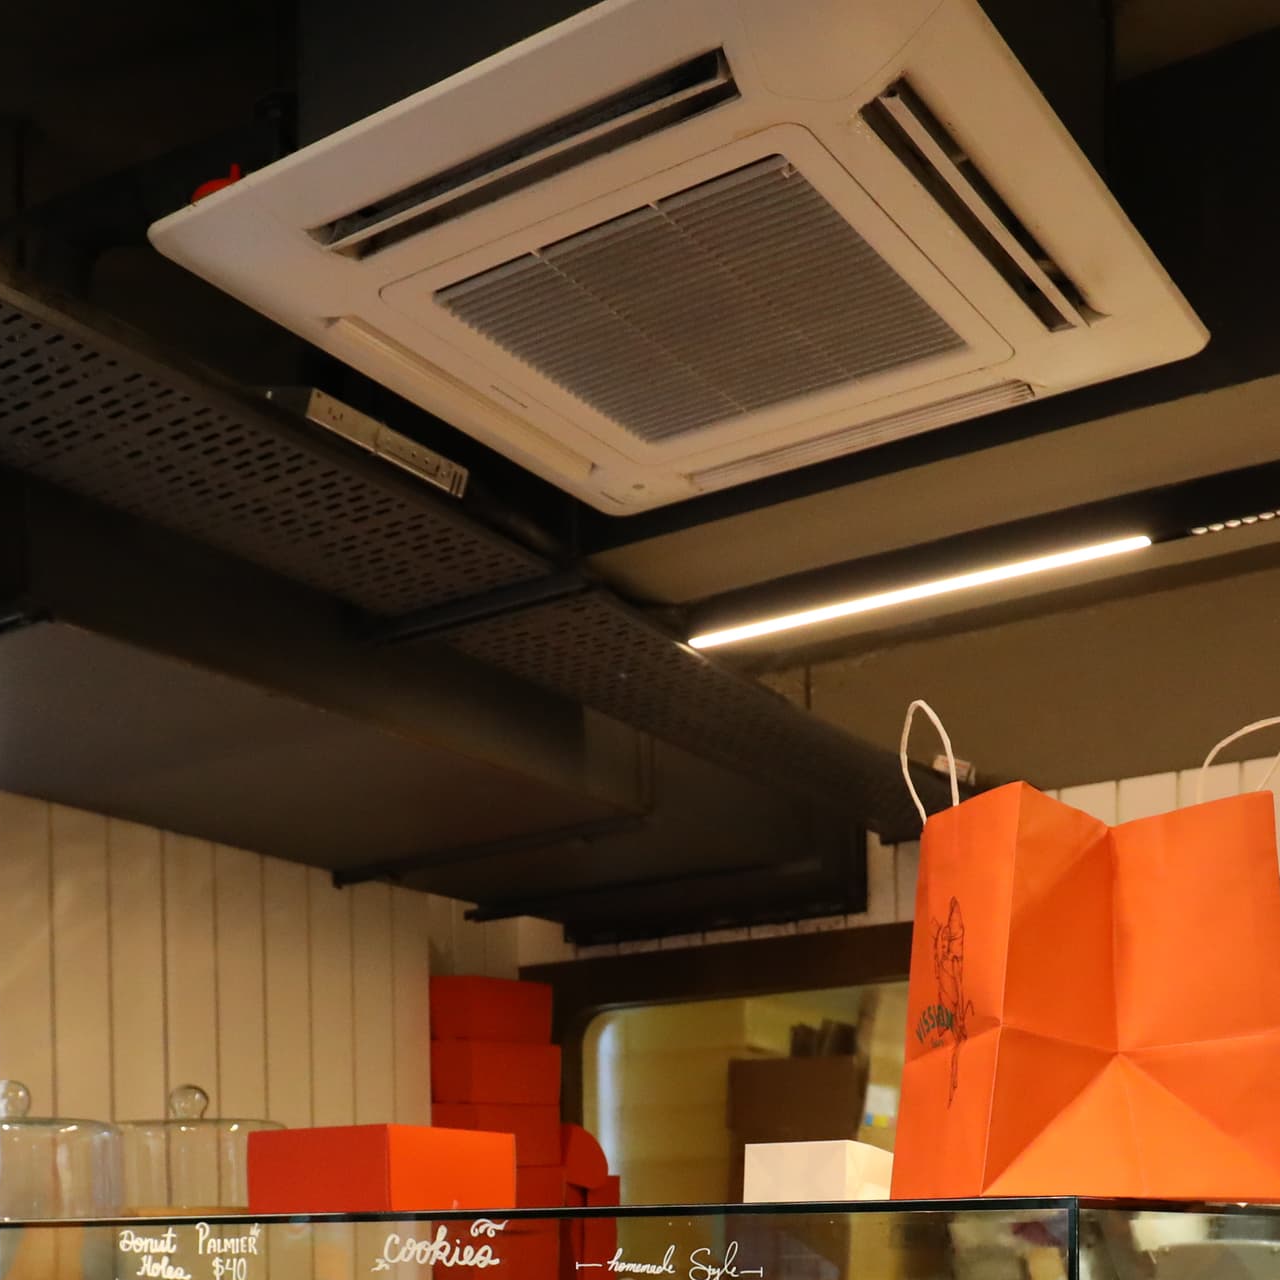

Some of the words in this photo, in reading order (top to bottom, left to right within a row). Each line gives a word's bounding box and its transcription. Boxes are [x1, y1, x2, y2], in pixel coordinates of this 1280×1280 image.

[119, 1226, 177, 1254] Donut
[195, 1222, 258, 1255] PALMIER
[383, 1225, 500, 1268] Cookies
[136, 1255, 192, 1280] Holes
